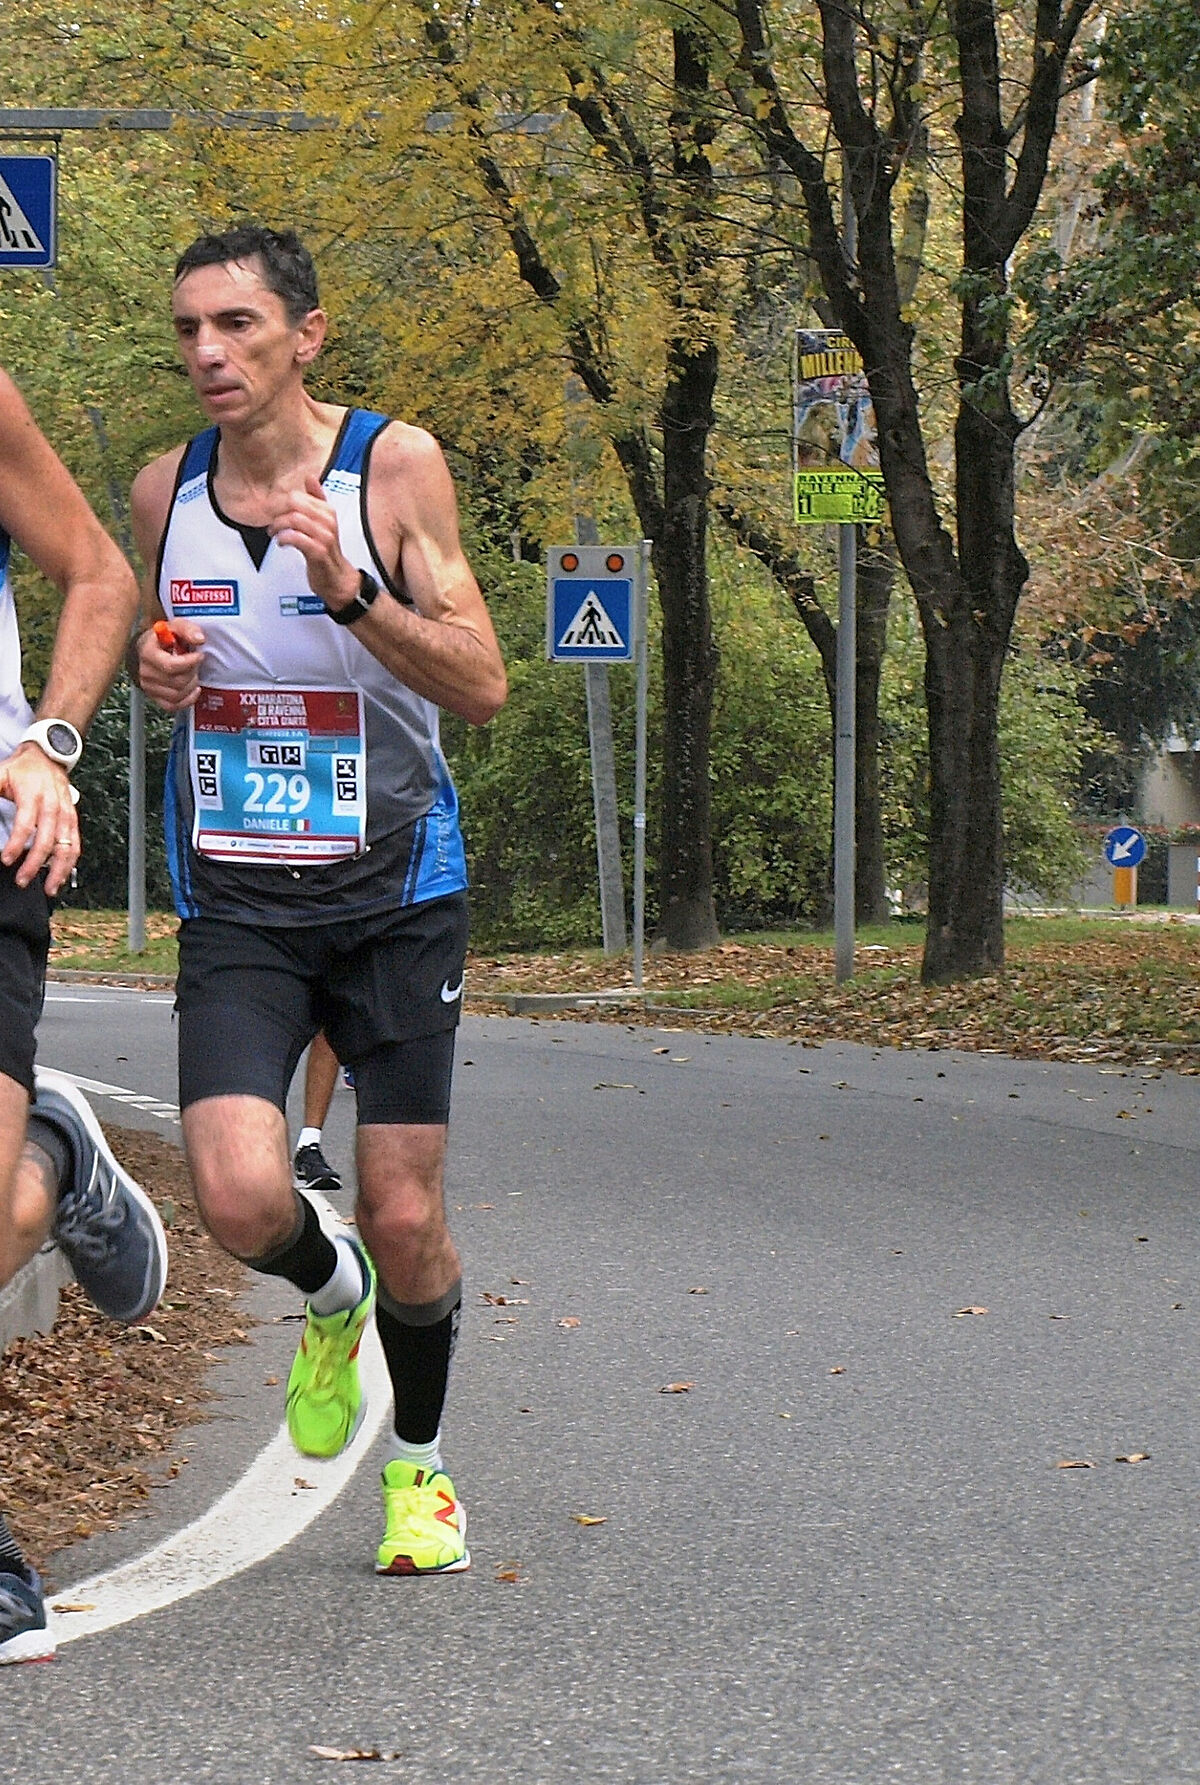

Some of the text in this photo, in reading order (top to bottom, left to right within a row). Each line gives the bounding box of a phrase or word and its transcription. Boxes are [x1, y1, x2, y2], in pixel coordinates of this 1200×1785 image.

[799, 475, 865, 483] RAVENNA
[171, 583, 230, 602] RG INFISSI
[239, 693, 304, 705] XX MARATONA
[243, 772, 311, 814] 229
[243, 817, 289, 831] DANIELE
